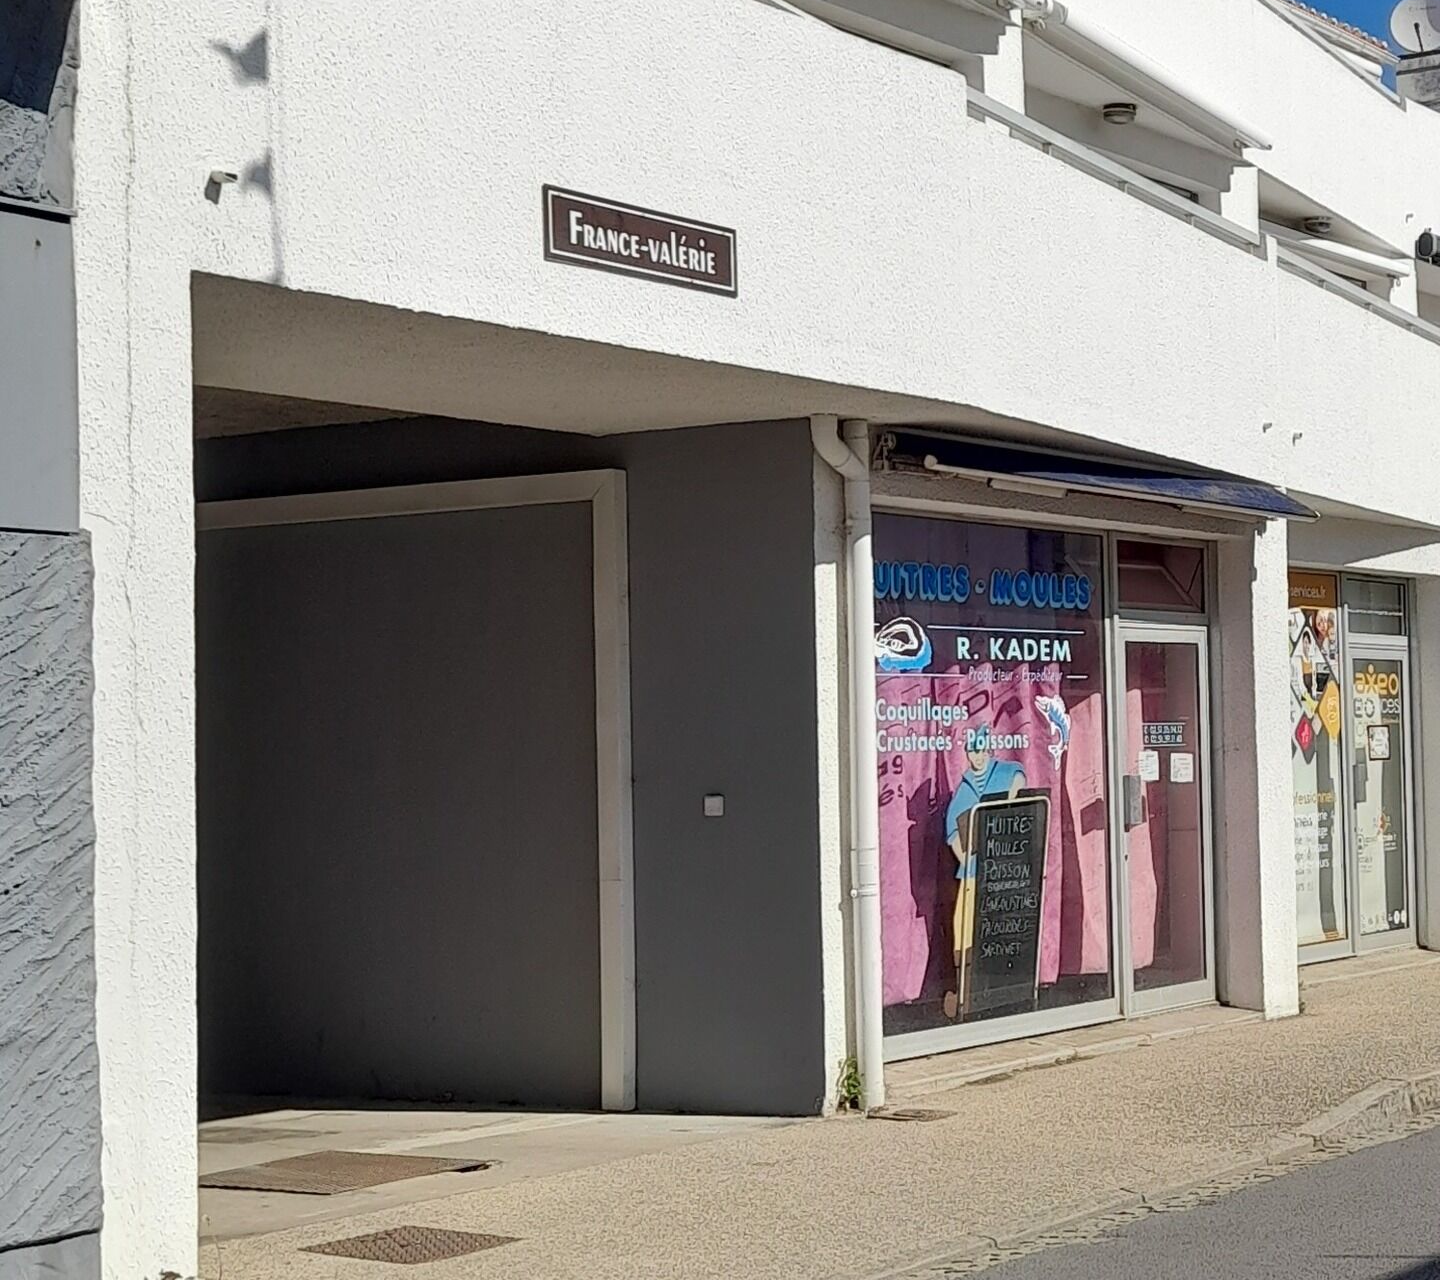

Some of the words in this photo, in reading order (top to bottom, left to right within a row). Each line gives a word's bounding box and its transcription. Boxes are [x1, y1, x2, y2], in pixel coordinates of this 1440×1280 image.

[874, 560, 970, 604] UITRES
[989, 568, 1091, 611] MOULES
[956, 636, 979, 660] R.
[989, 637, 1072, 662] KADEM
[875, 696, 969, 727] Coquillages
[876, 728, 953, 753] Crustacés
[966, 728, 1030, 751] Poissons
[985, 815, 1034, 837] HUITRES
[986, 838, 1030, 858] MOULES
